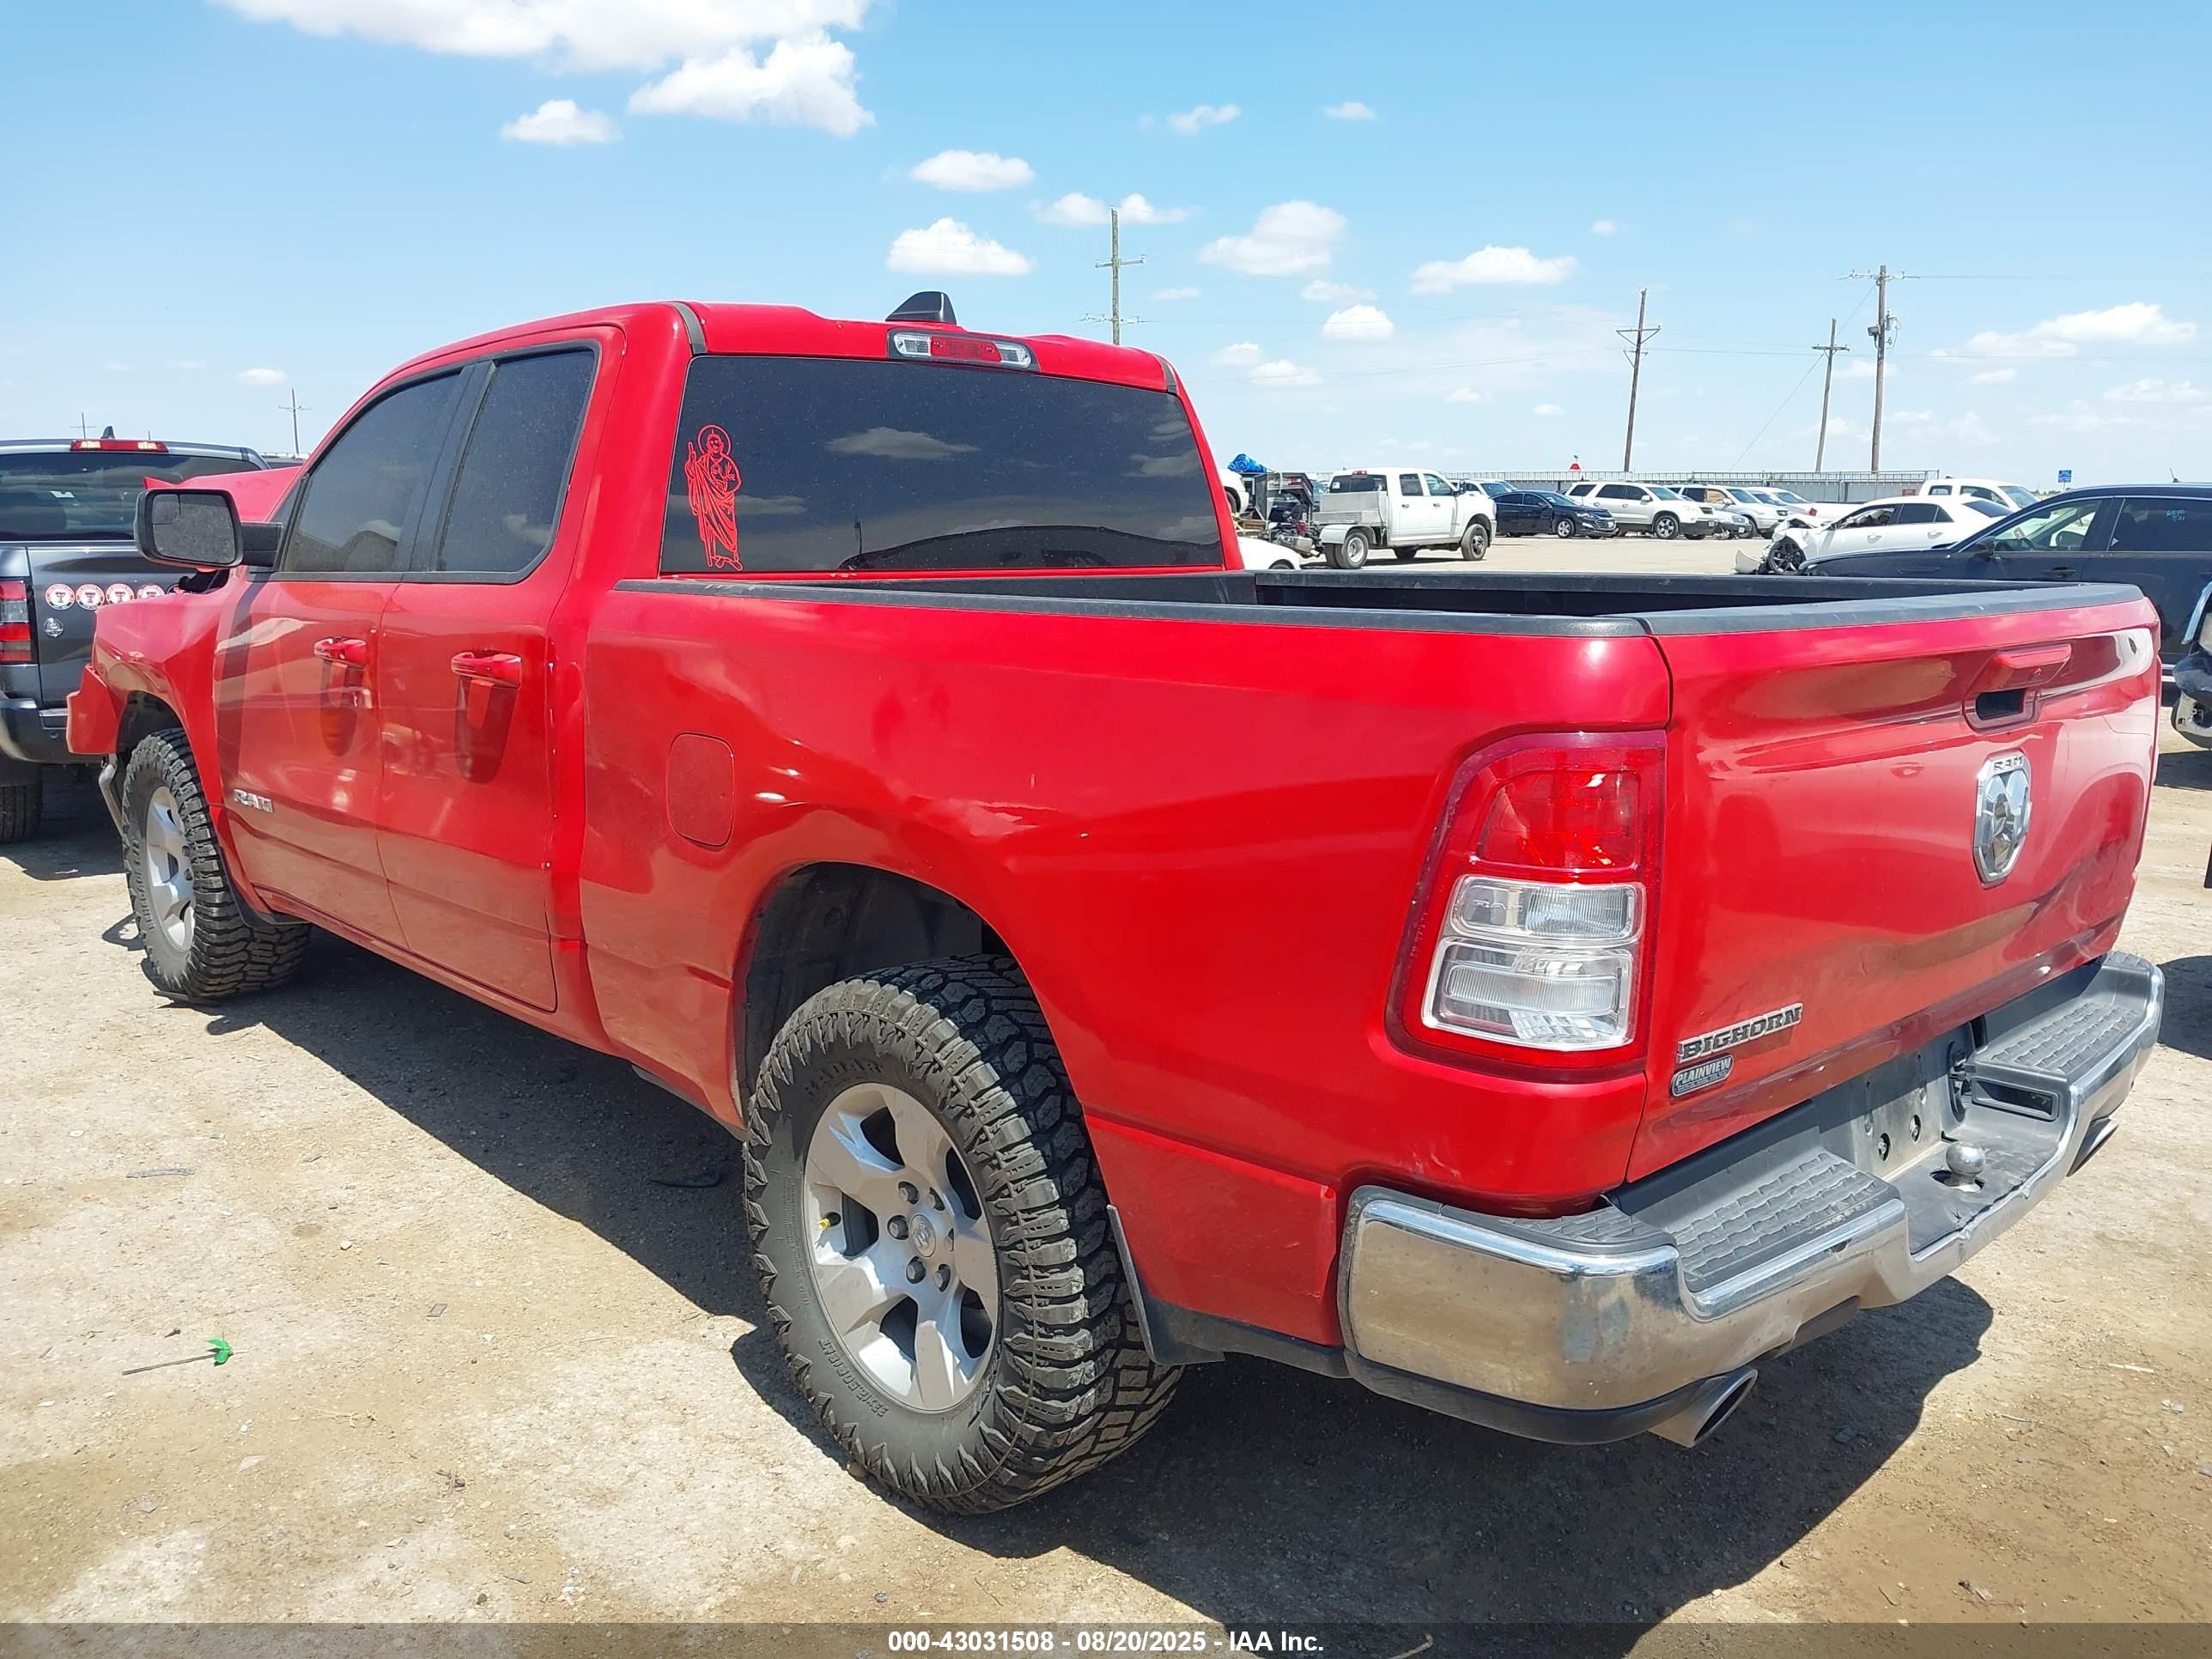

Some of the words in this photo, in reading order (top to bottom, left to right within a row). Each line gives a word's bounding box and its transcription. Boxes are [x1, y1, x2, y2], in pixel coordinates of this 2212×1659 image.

[1992, 755, 2025, 771] RAM
[233, 788, 274, 814] RAM
[1473, 899, 1524, 913] RAM
[1678, 1003, 1803, 1063] BIGHORN
[1674, 1057, 1733, 1086] PLAINVIEW
